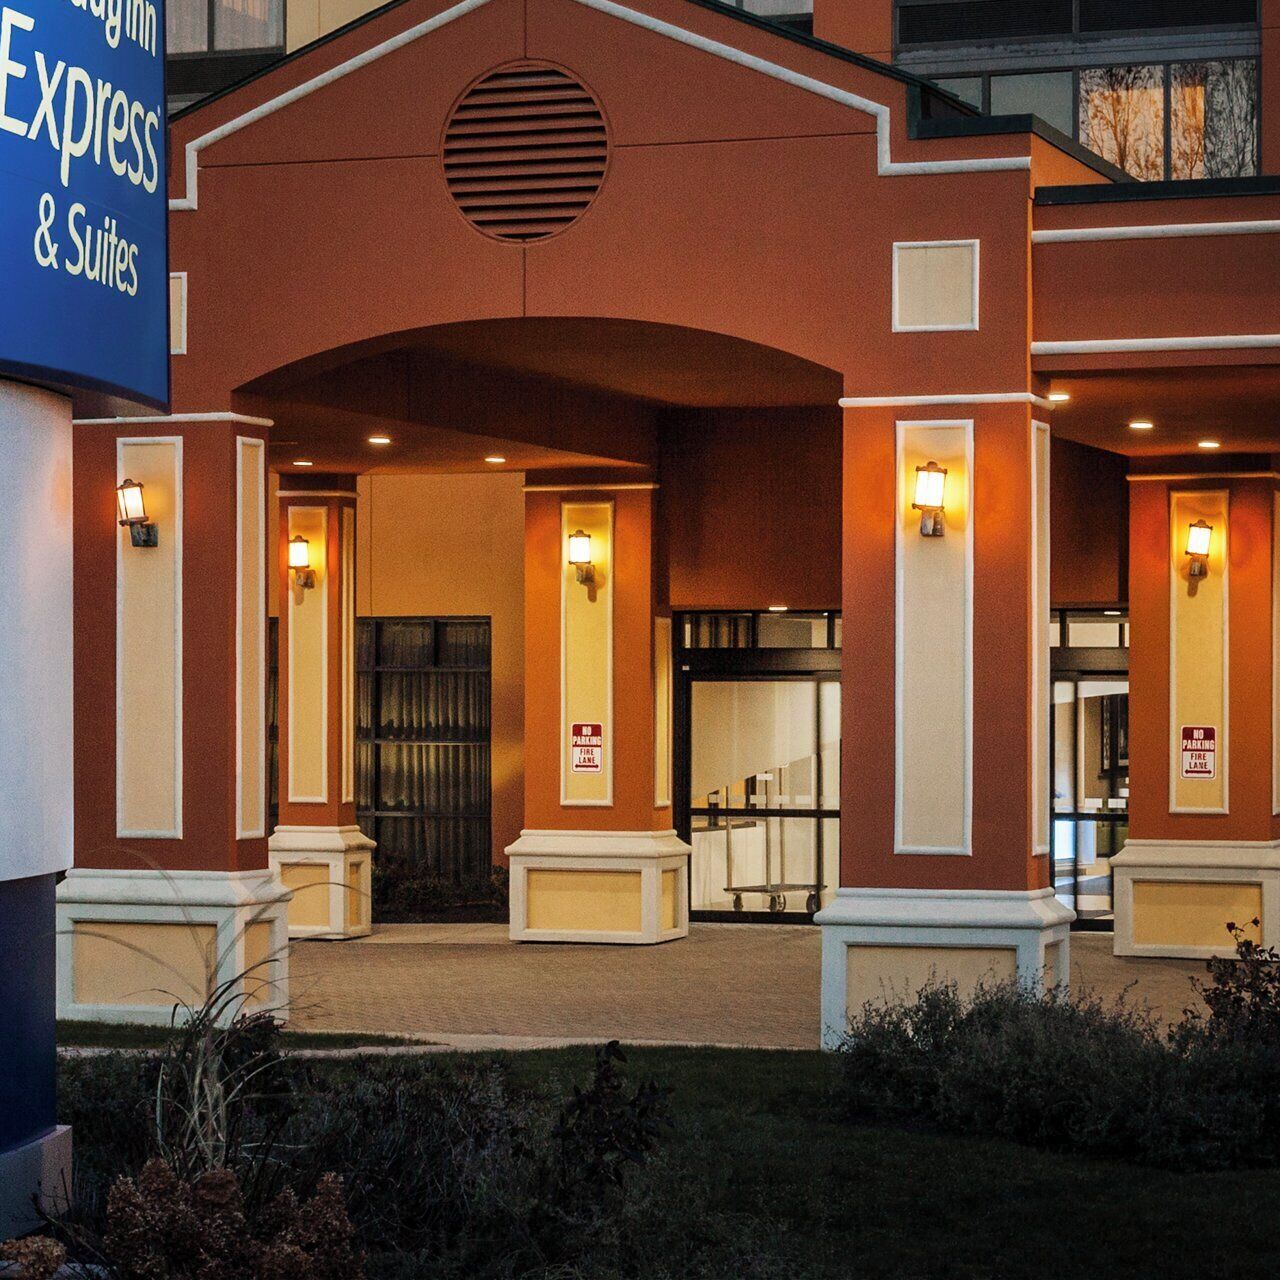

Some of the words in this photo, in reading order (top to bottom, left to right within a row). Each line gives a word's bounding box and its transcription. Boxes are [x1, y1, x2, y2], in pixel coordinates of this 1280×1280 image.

[34, 192, 59, 269] &
[65, 202, 138, 297] Suites
[582, 726, 592, 735] NO
[1193, 729, 1204, 739] NO
[573, 736, 602, 745] PARKING
[1183, 740, 1214, 749] PARKING
